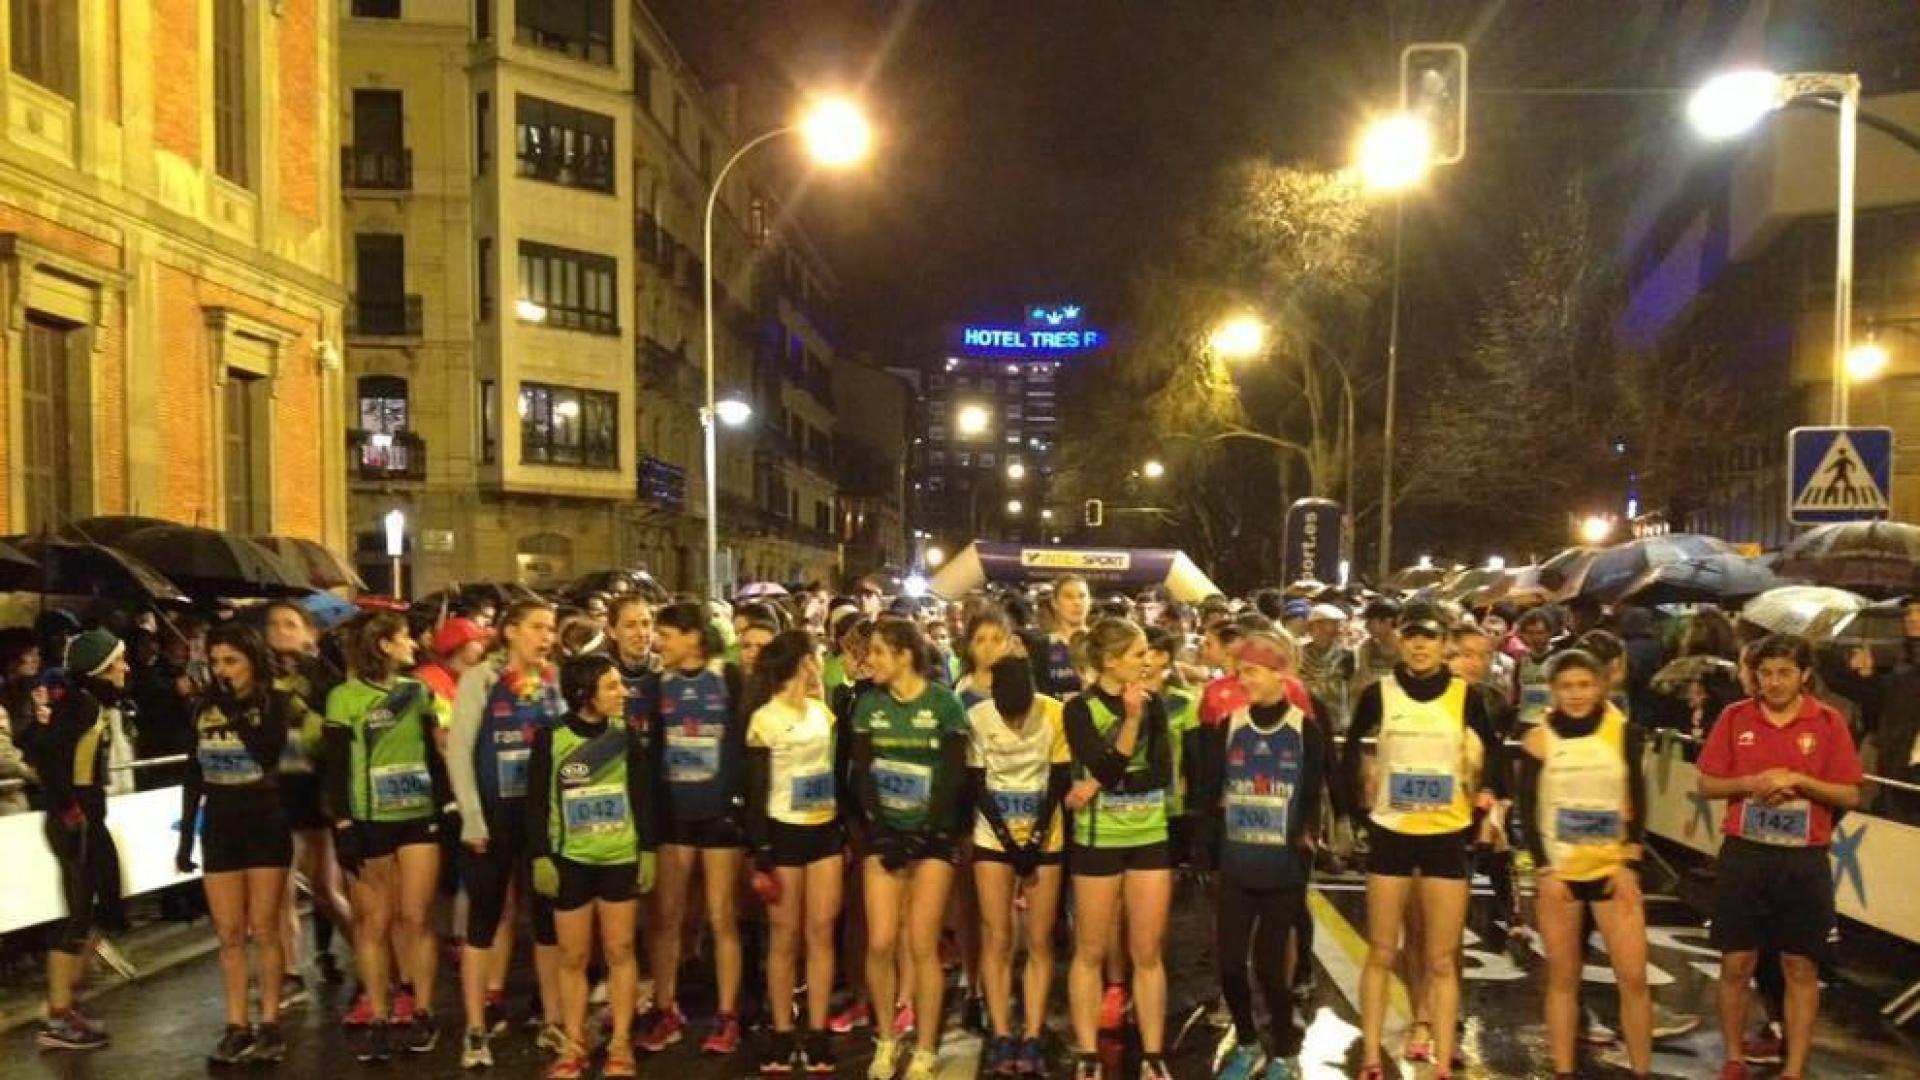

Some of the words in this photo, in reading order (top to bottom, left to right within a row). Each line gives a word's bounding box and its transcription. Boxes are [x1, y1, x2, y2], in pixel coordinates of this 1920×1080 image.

[964, 328, 1026, 348] HOTEL
[1029, 331, 1081, 348] TRES
[1401, 776, 1441, 799] 470
[577, 800, 616, 821] 042
[1756, 813, 1797, 833] 142
